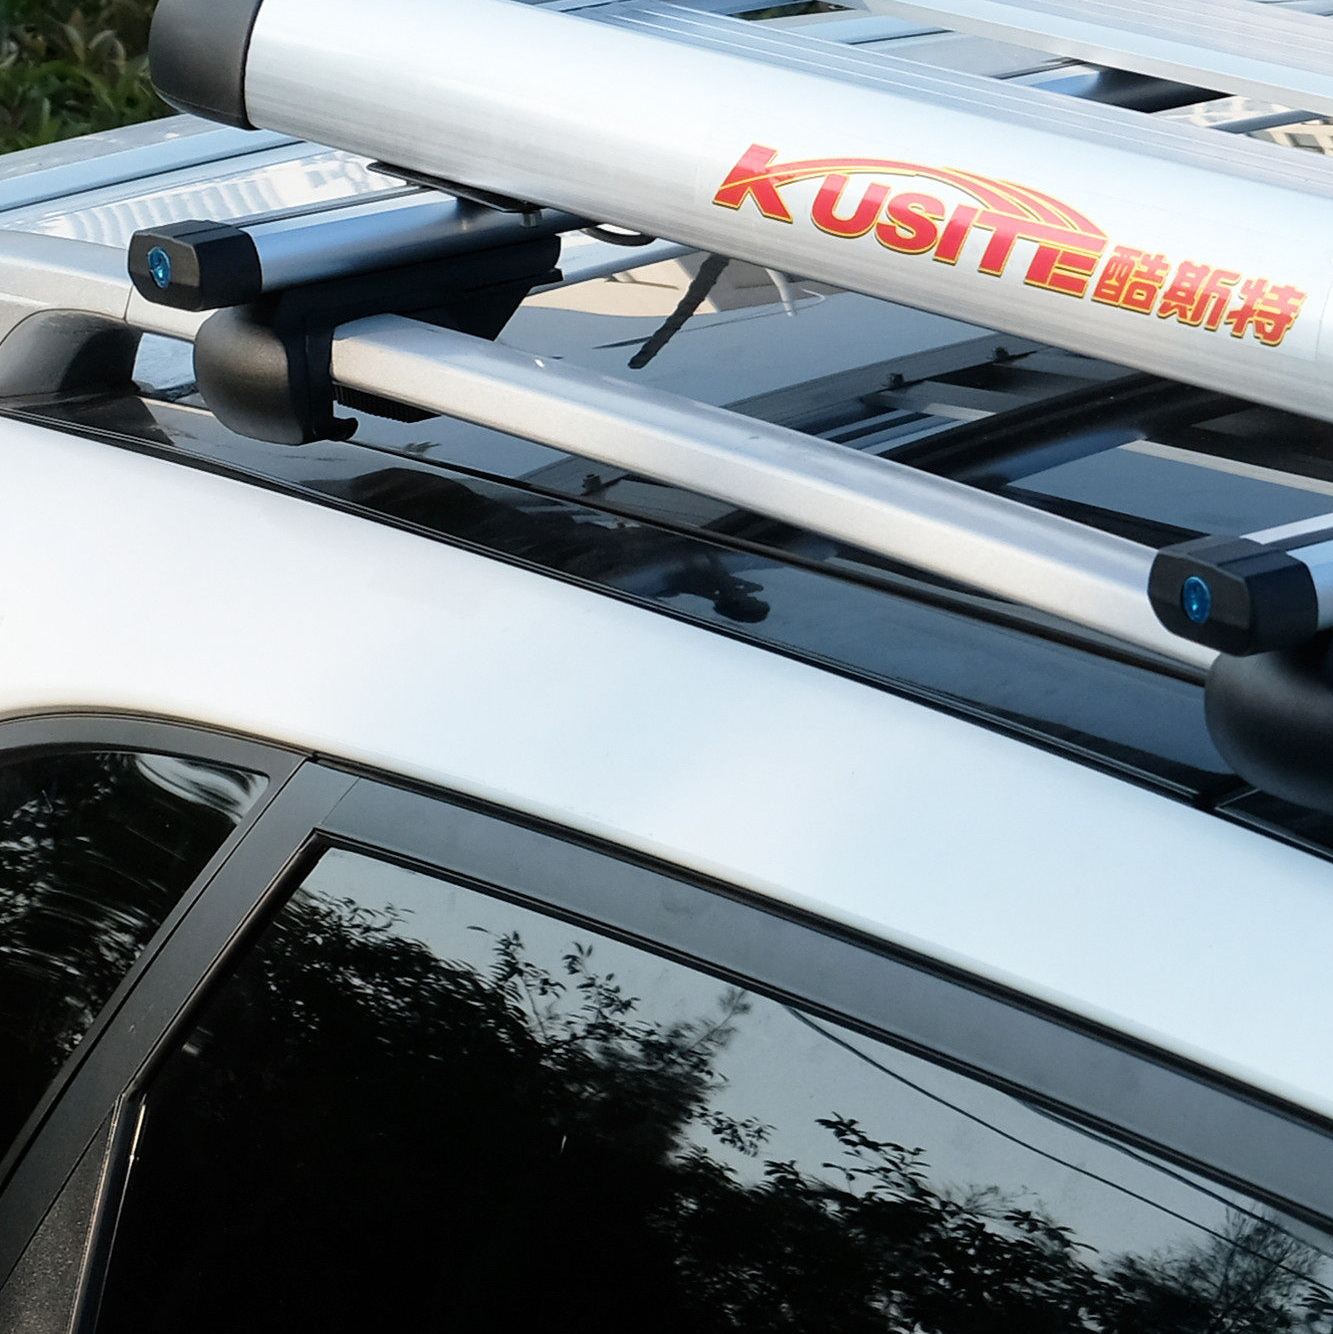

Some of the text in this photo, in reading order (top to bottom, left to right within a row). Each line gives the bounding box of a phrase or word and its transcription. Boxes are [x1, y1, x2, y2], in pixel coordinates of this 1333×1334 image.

[712, 143, 1308, 347] KUSITE 酷斯特
